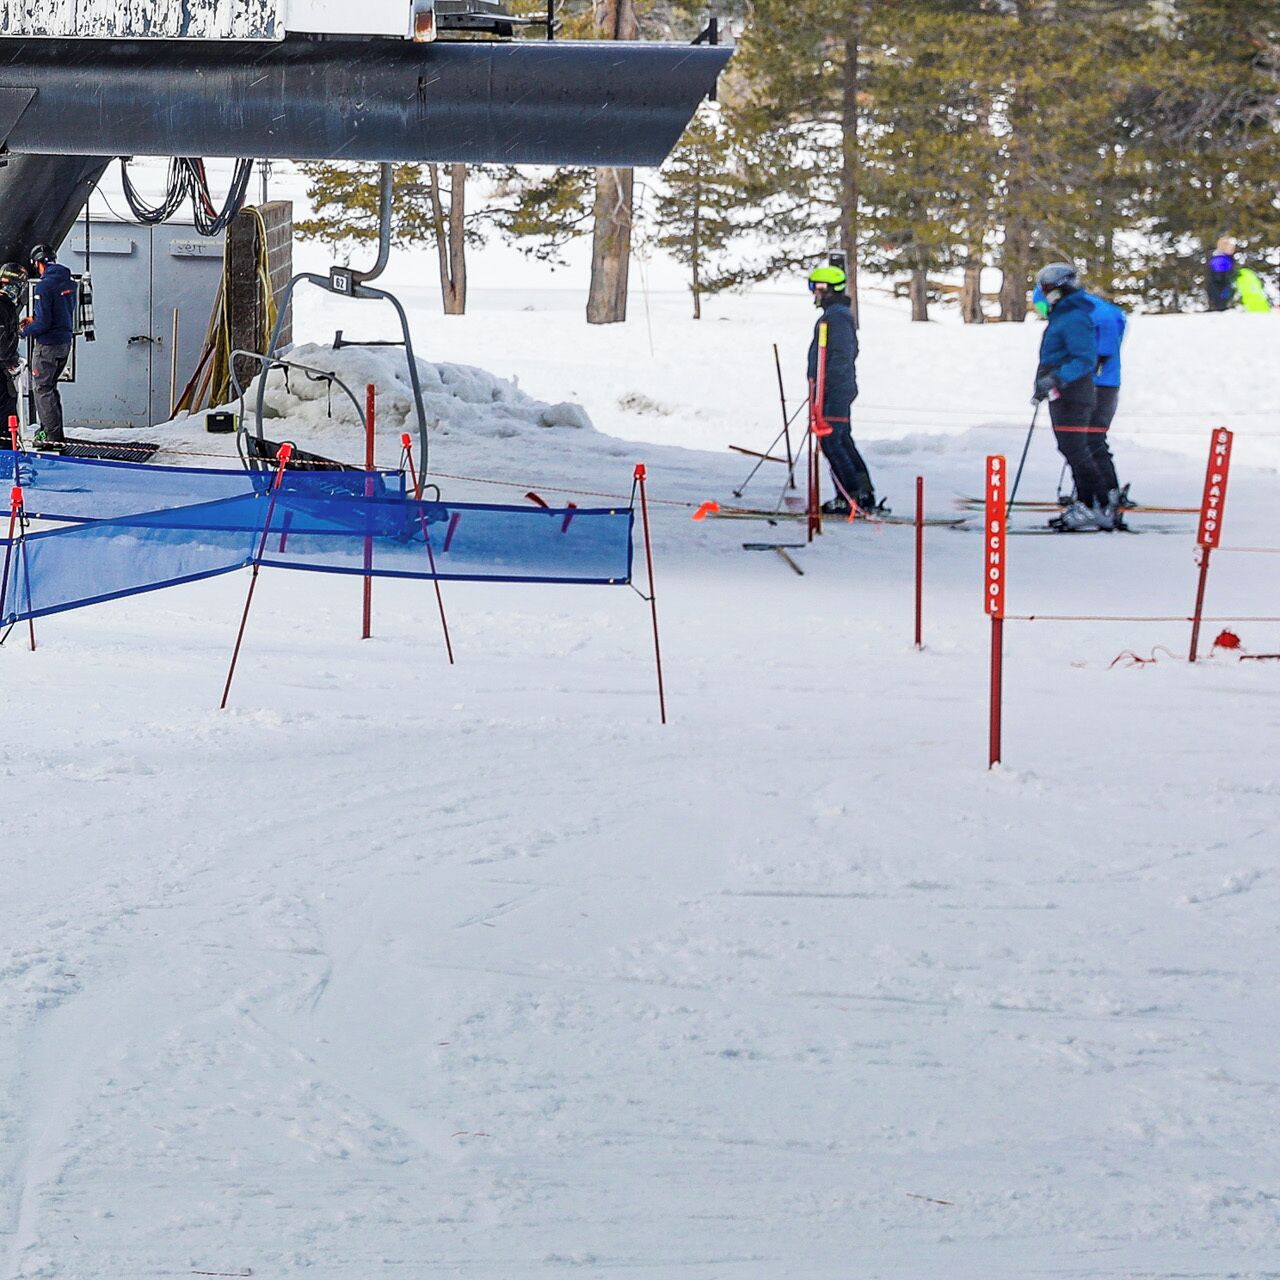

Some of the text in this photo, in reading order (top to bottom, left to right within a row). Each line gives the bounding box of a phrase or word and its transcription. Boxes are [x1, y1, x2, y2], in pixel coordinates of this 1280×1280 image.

[336, 277, 344, 288] 62
[989, 458, 1001, 612] SKI SCHOOL
[1204, 431, 1228, 543] SKI PATROL
